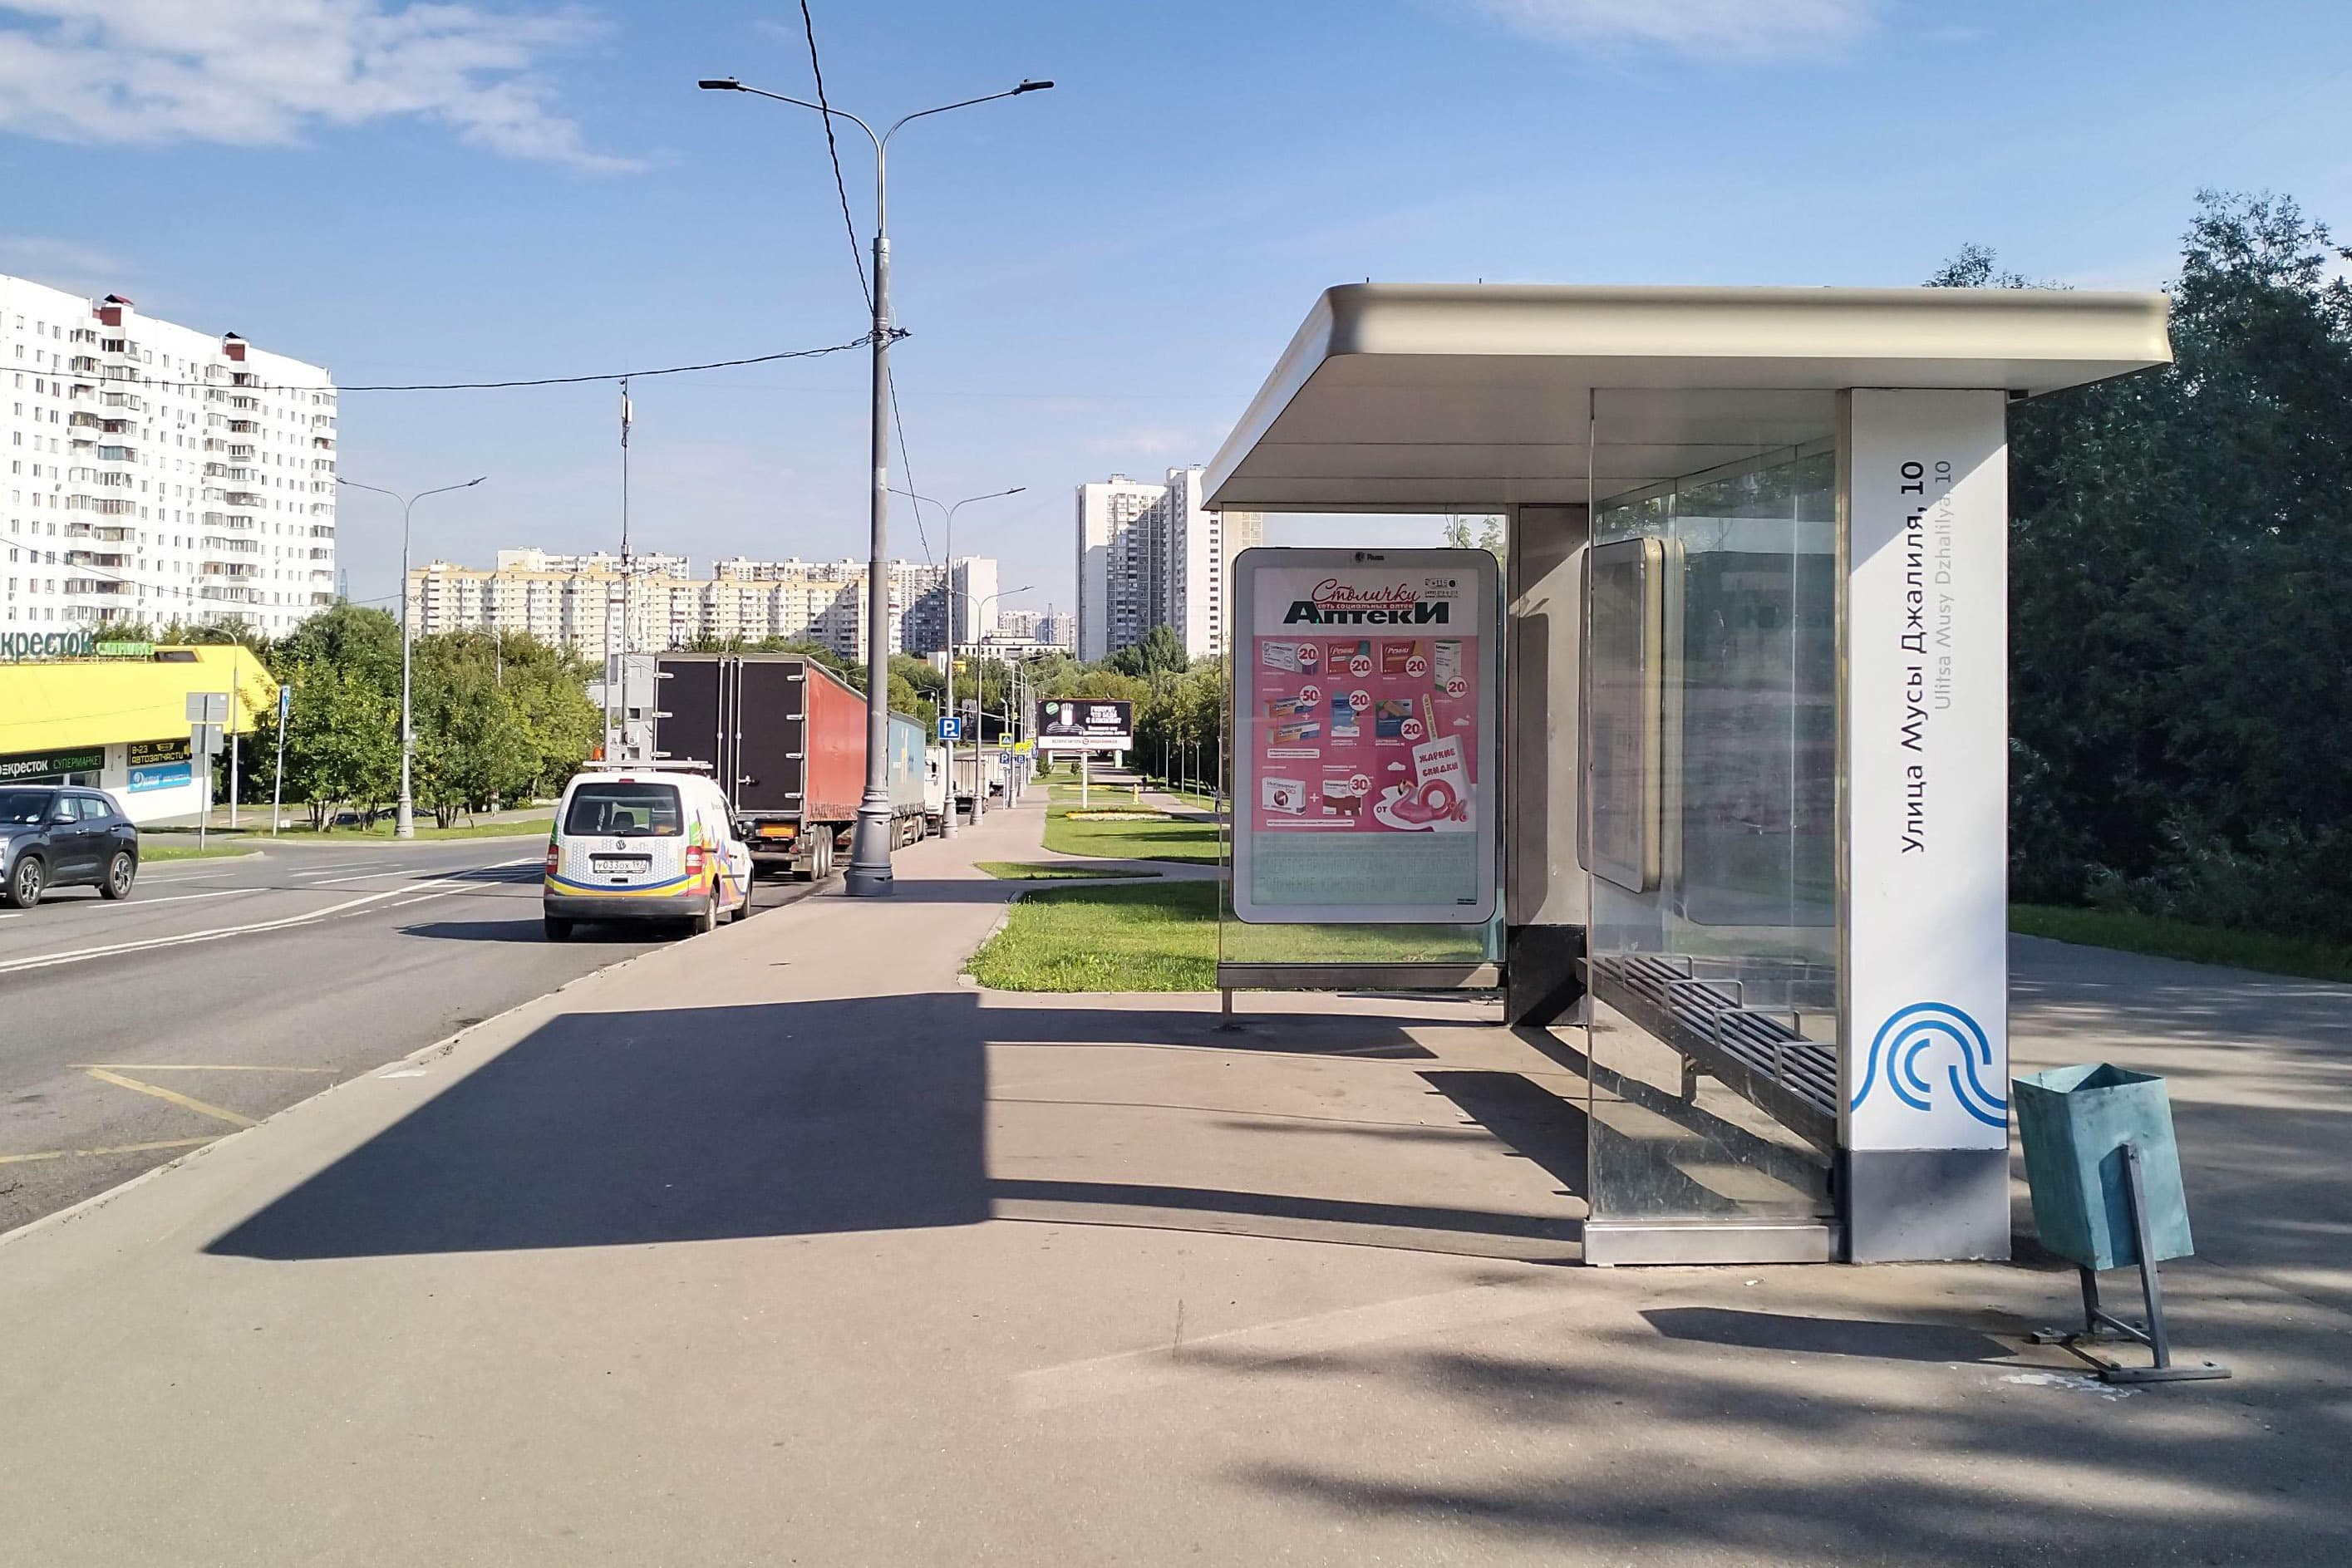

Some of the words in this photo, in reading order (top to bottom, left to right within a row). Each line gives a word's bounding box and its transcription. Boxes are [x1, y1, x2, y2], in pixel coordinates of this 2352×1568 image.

[1901, 461, 1924, 494] 10
[1935, 460, 1951, 483] 10
[1311, 578, 1421, 602] Столички
[1901, 507, 1928, 654] Джалиля,
[1935, 593, 1955, 647] Musy
[1, 631, 95, 664] кресток
[1935, 656, 1951, 710] Ulitsa
[1901, 666, 1928, 752] Мусы
[0, 759, 48, 777] екресток
[1419, 748, 1456, 764] ЖАРКИЕ
[1422, 762, 1459, 777] СКИДКИ
[1902, 765, 1927, 853] Улица
